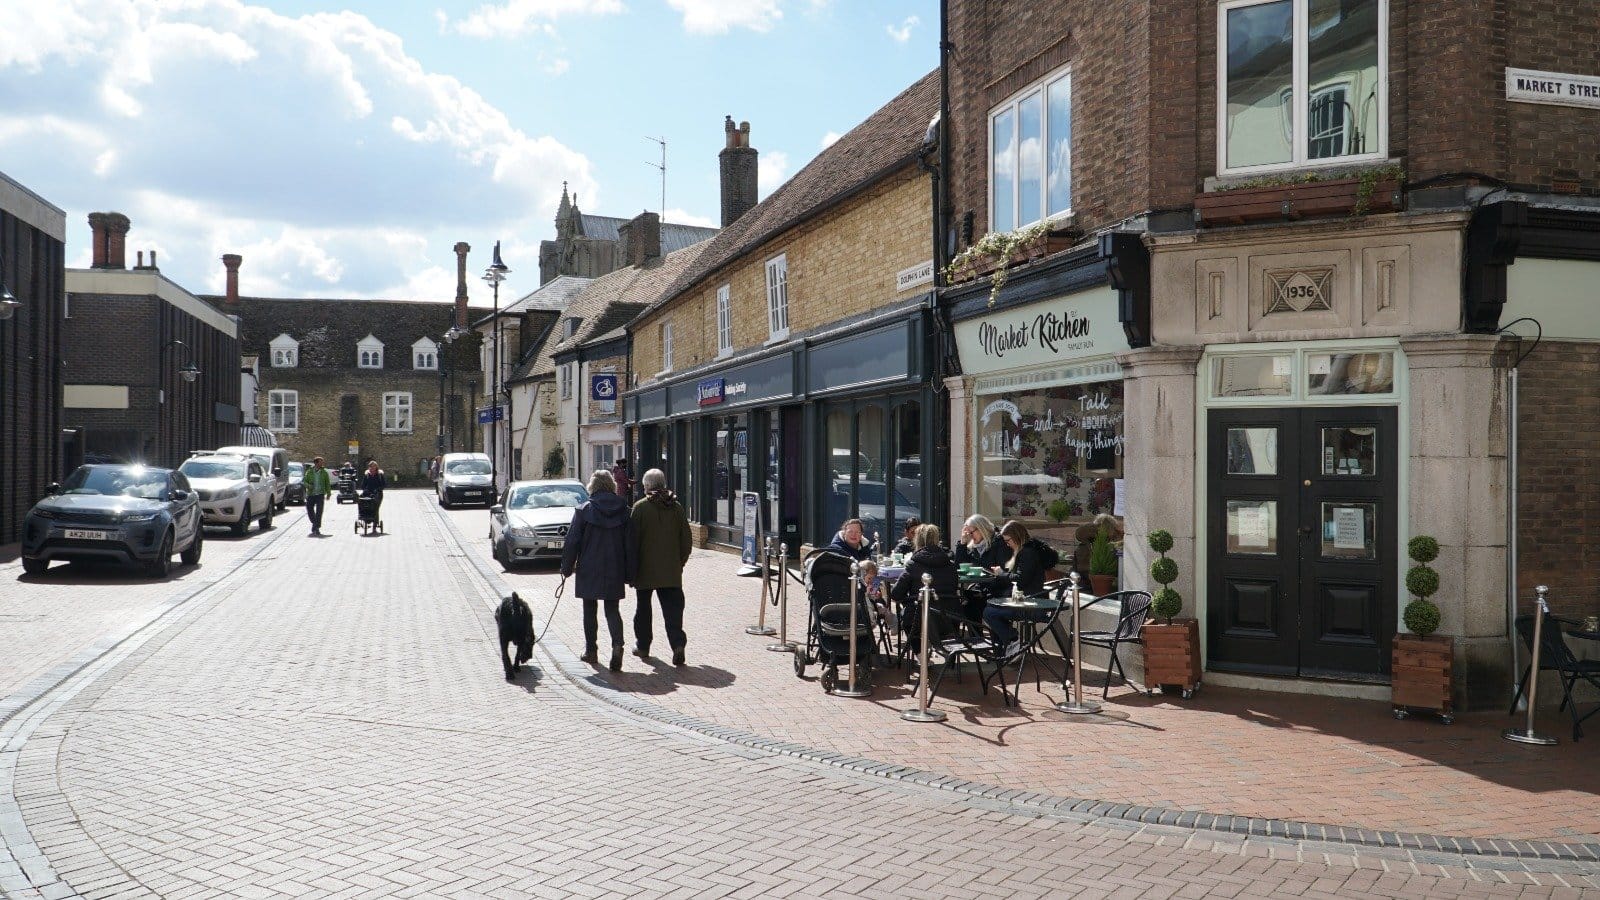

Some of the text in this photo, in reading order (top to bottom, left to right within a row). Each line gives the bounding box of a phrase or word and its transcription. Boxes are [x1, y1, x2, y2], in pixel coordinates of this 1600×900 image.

[1517, 79, 1600, 98] MARKET STRE
[900, 267, 930, 285] DOLPHIN LANE
[1286, 286, 1314, 298] 1936
[979, 312, 1090, 357] Market Kitchen
[1078, 392, 1109, 411] Talk
[1034, 409, 1053, 431] and
[1065, 429, 1093, 459] happy
